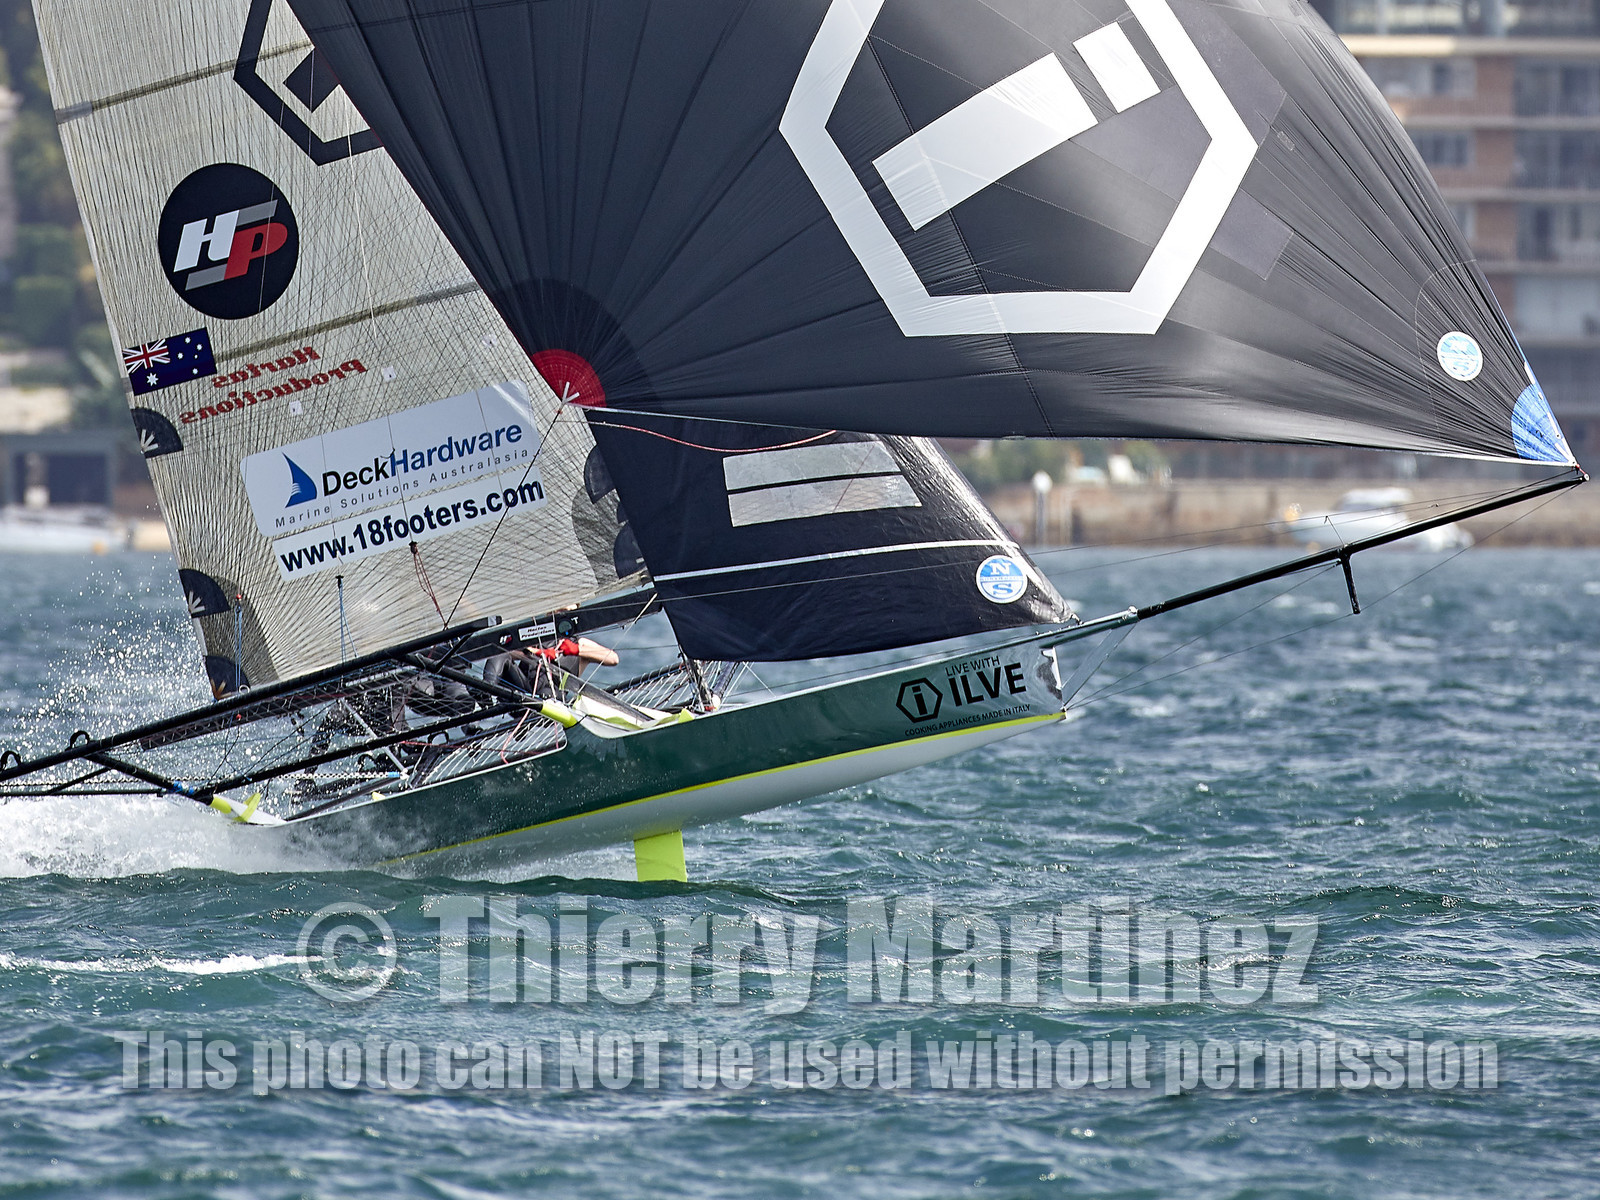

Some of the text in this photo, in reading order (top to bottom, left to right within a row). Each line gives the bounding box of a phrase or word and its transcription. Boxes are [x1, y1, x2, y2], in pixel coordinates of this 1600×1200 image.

[174, 209, 288, 281] HP
[275, 449, 528, 529] Marine Solutions Australasia
[322, 423, 523, 497] DeckHardware
[280, 478, 545, 572] www.18footers.com
[945, 656, 1000, 677] LIVE WITH
[948, 662, 1027, 707] ILVE
[904, 703, 1031, 737] COOKING APPLIANCES MADE IN ITALY
